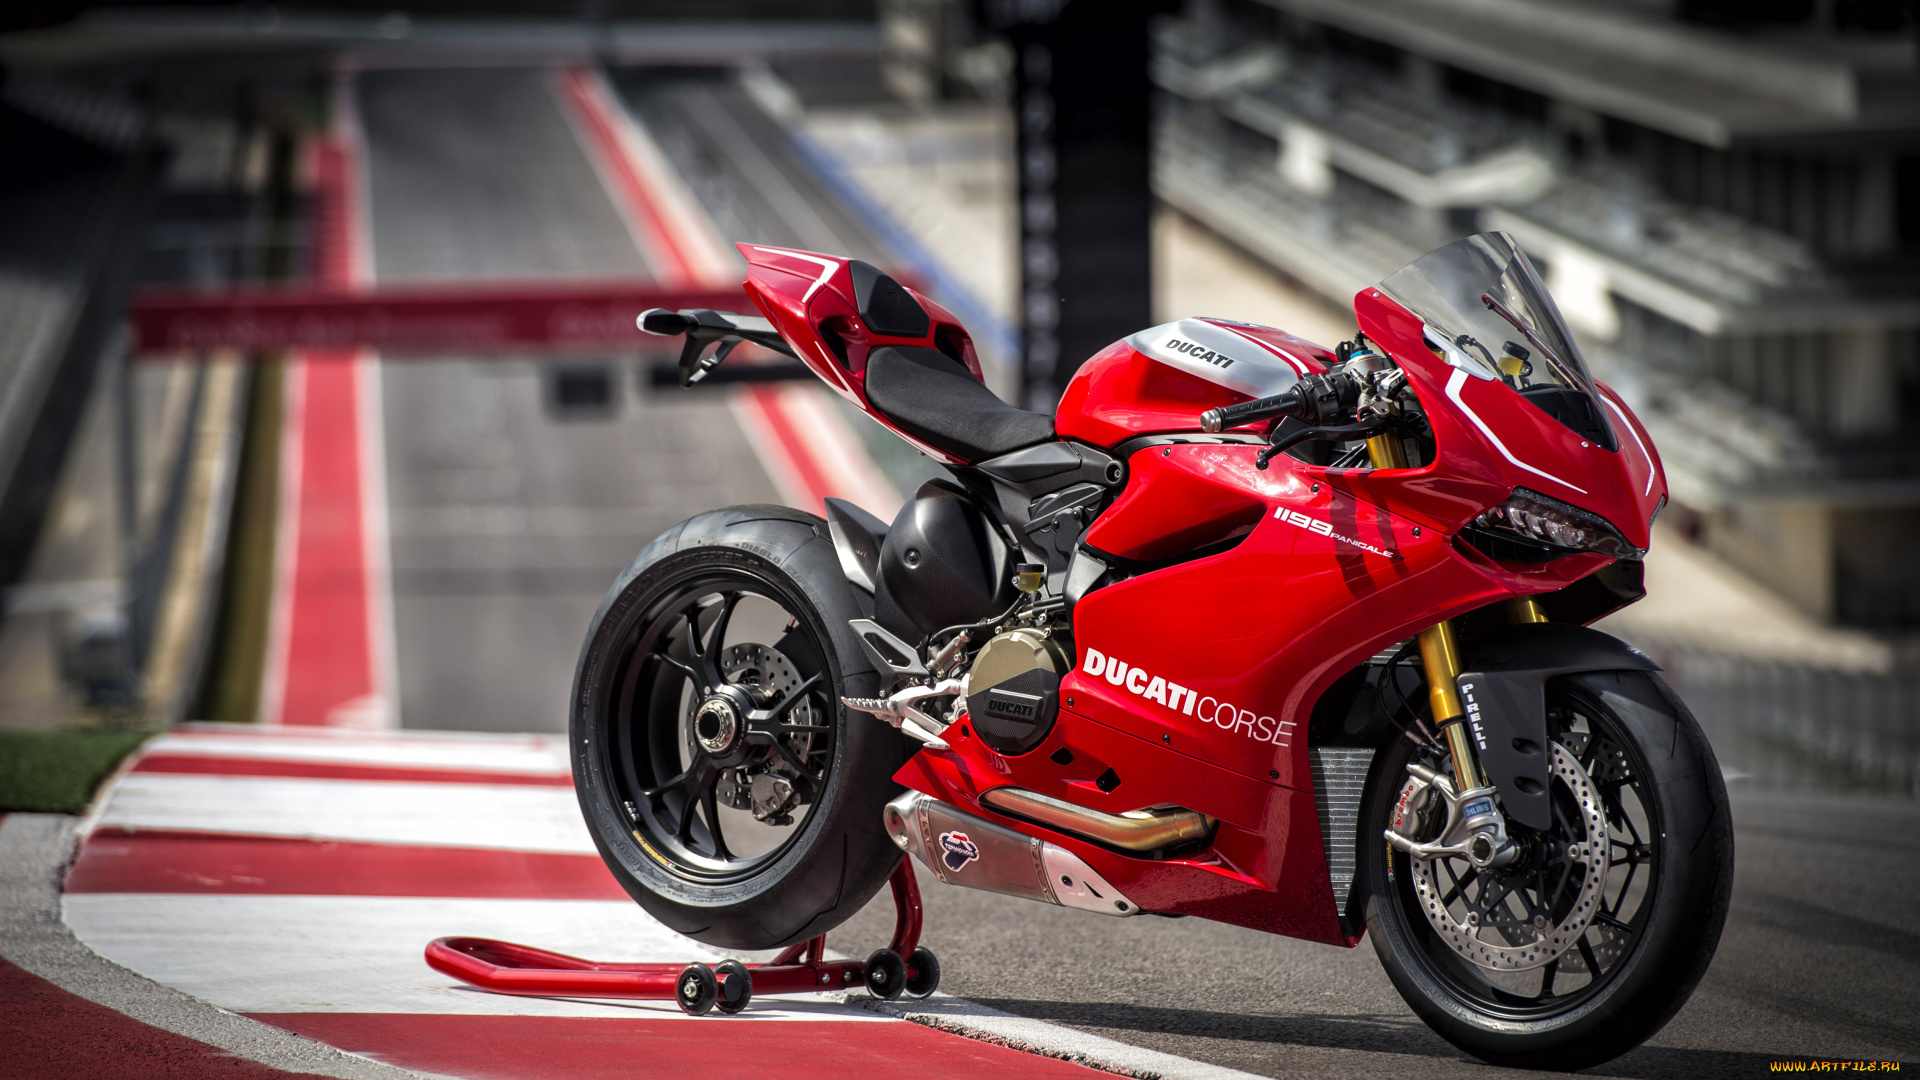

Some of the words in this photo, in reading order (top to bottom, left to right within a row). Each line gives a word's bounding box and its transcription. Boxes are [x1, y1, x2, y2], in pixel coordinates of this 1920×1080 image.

[1165, 339, 1235, 369] DUCATI
[1273, 506, 1333, 537] 1199
[1330, 532, 1394, 558] PANIGALE
[988, 699, 1034, 717] DUCATI
[1083, 647, 1198, 716] DUCATI
[1197, 696, 1298, 747] CORSE
[1461, 683, 1487, 750] PIRELLI
[1395, 785, 1414, 826] brembo
